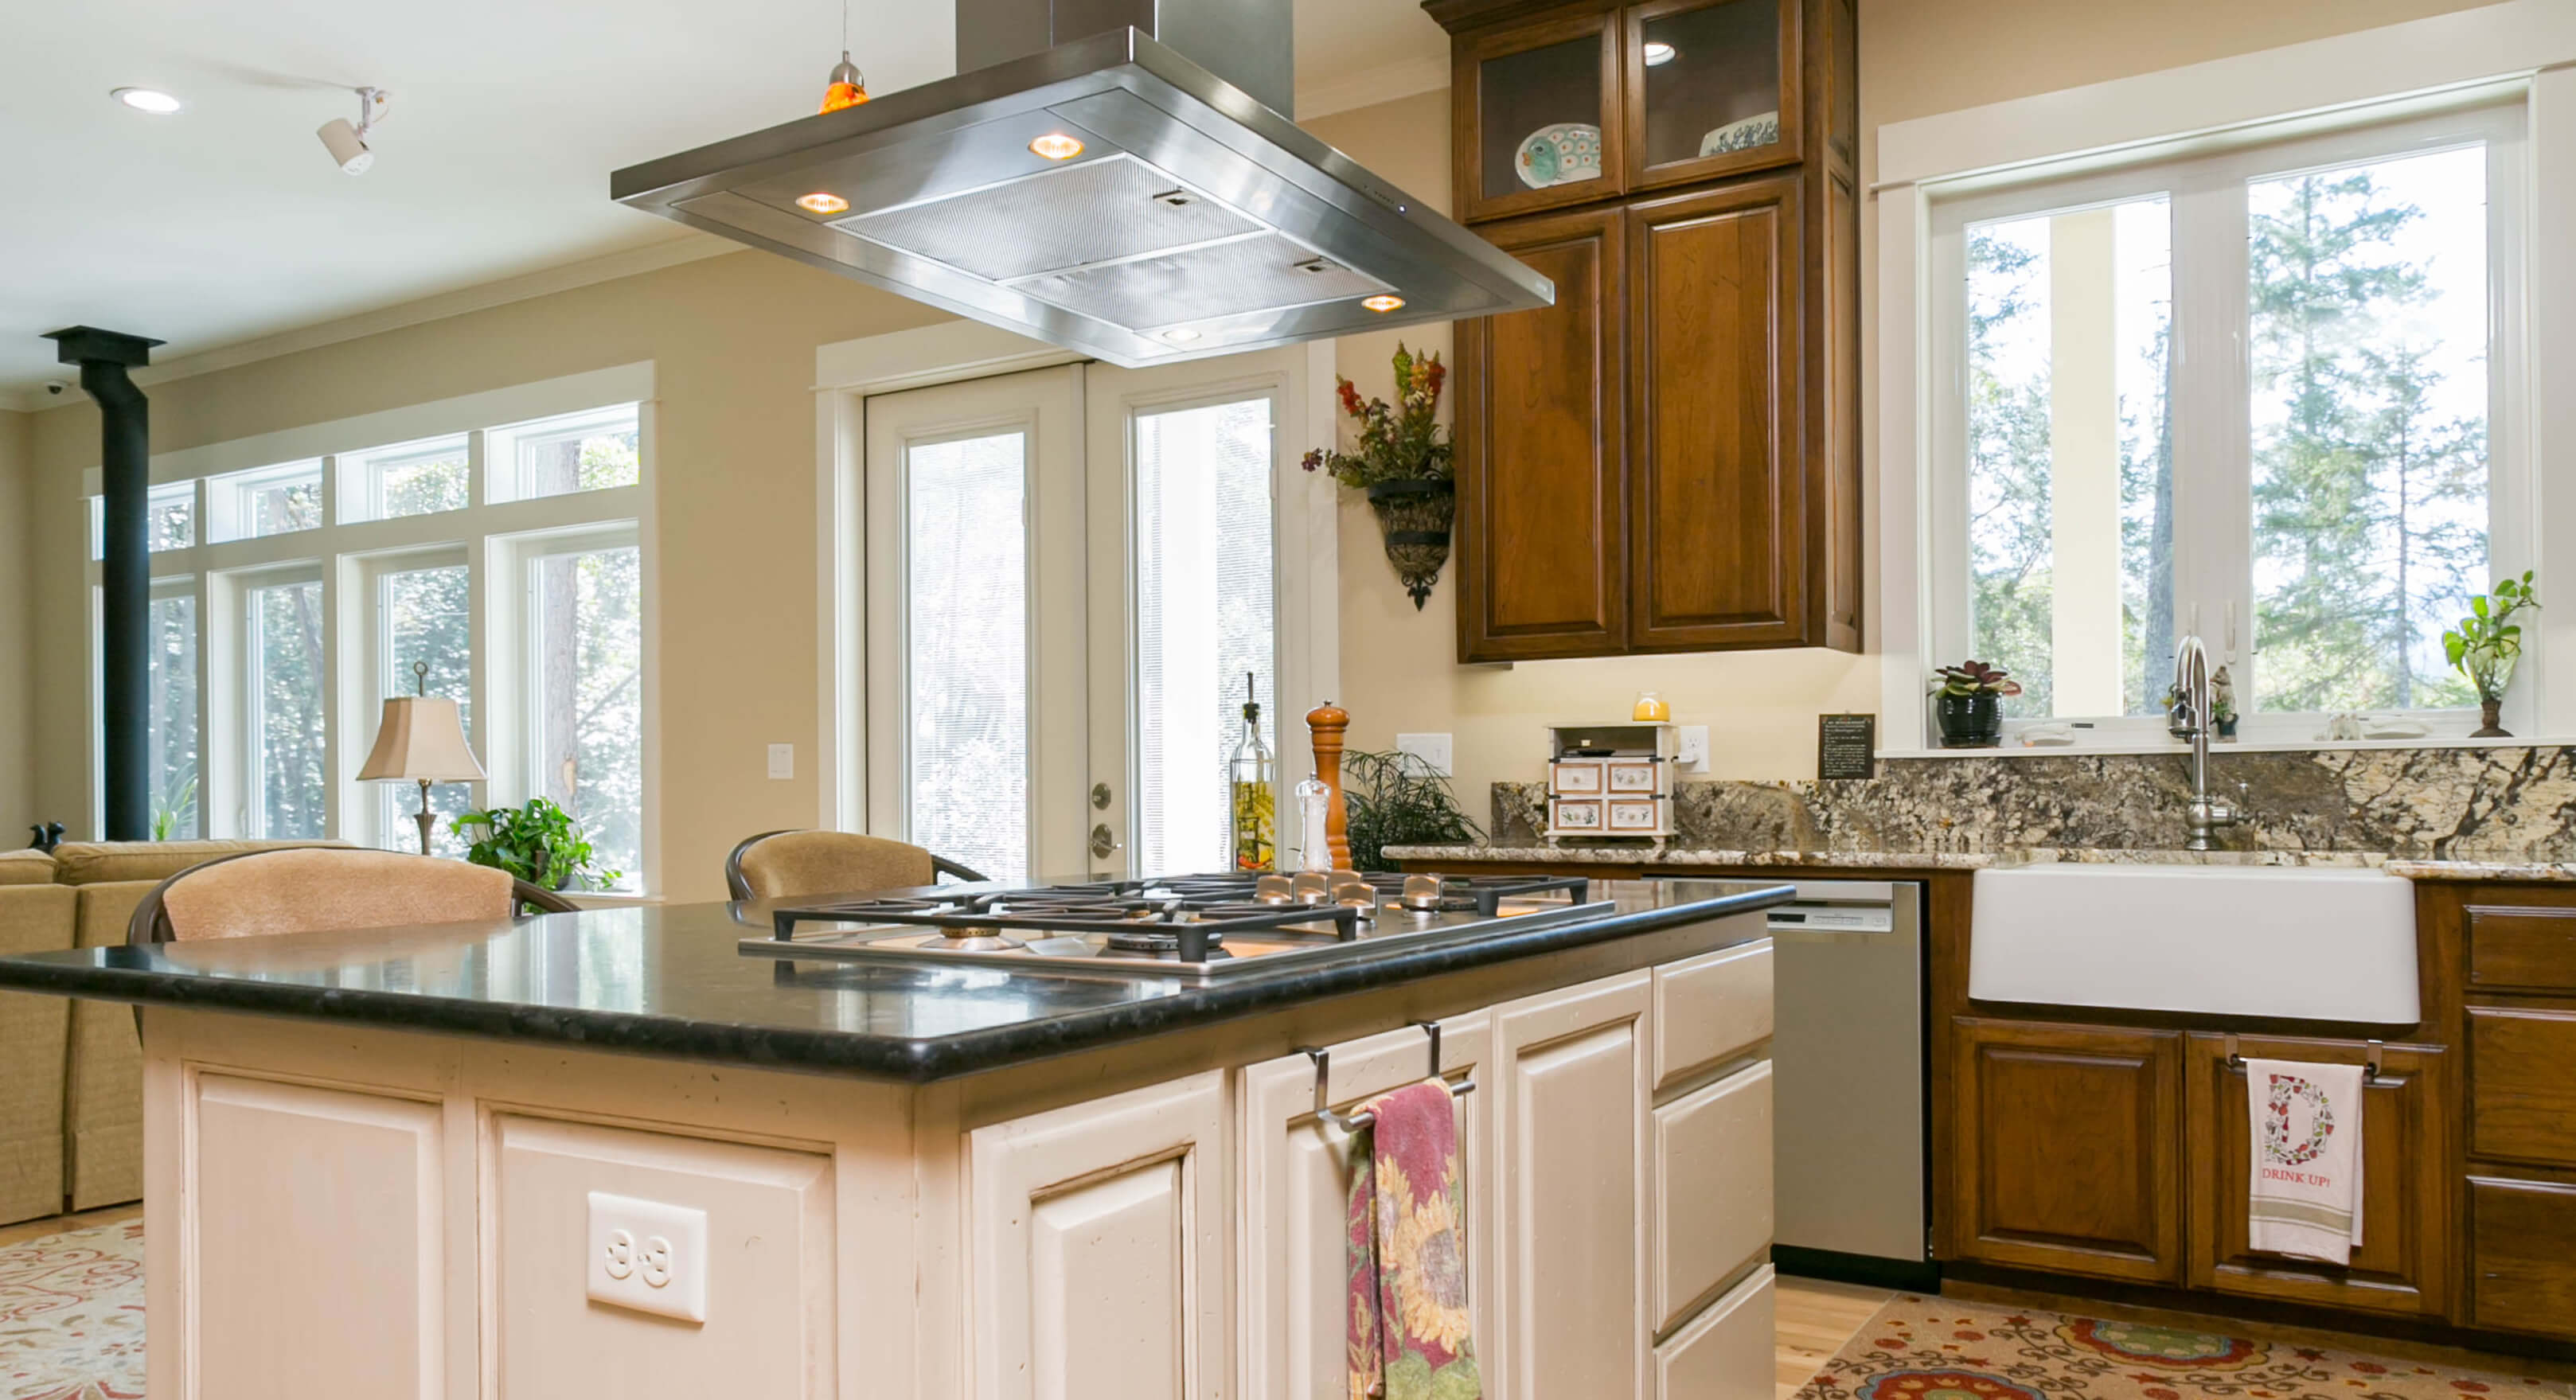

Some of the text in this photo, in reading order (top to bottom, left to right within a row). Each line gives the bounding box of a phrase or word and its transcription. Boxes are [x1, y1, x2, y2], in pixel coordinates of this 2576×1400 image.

[2265, 1074, 2335, 1165] D
[2262, 1168, 2331, 1188] DRINK UP!
